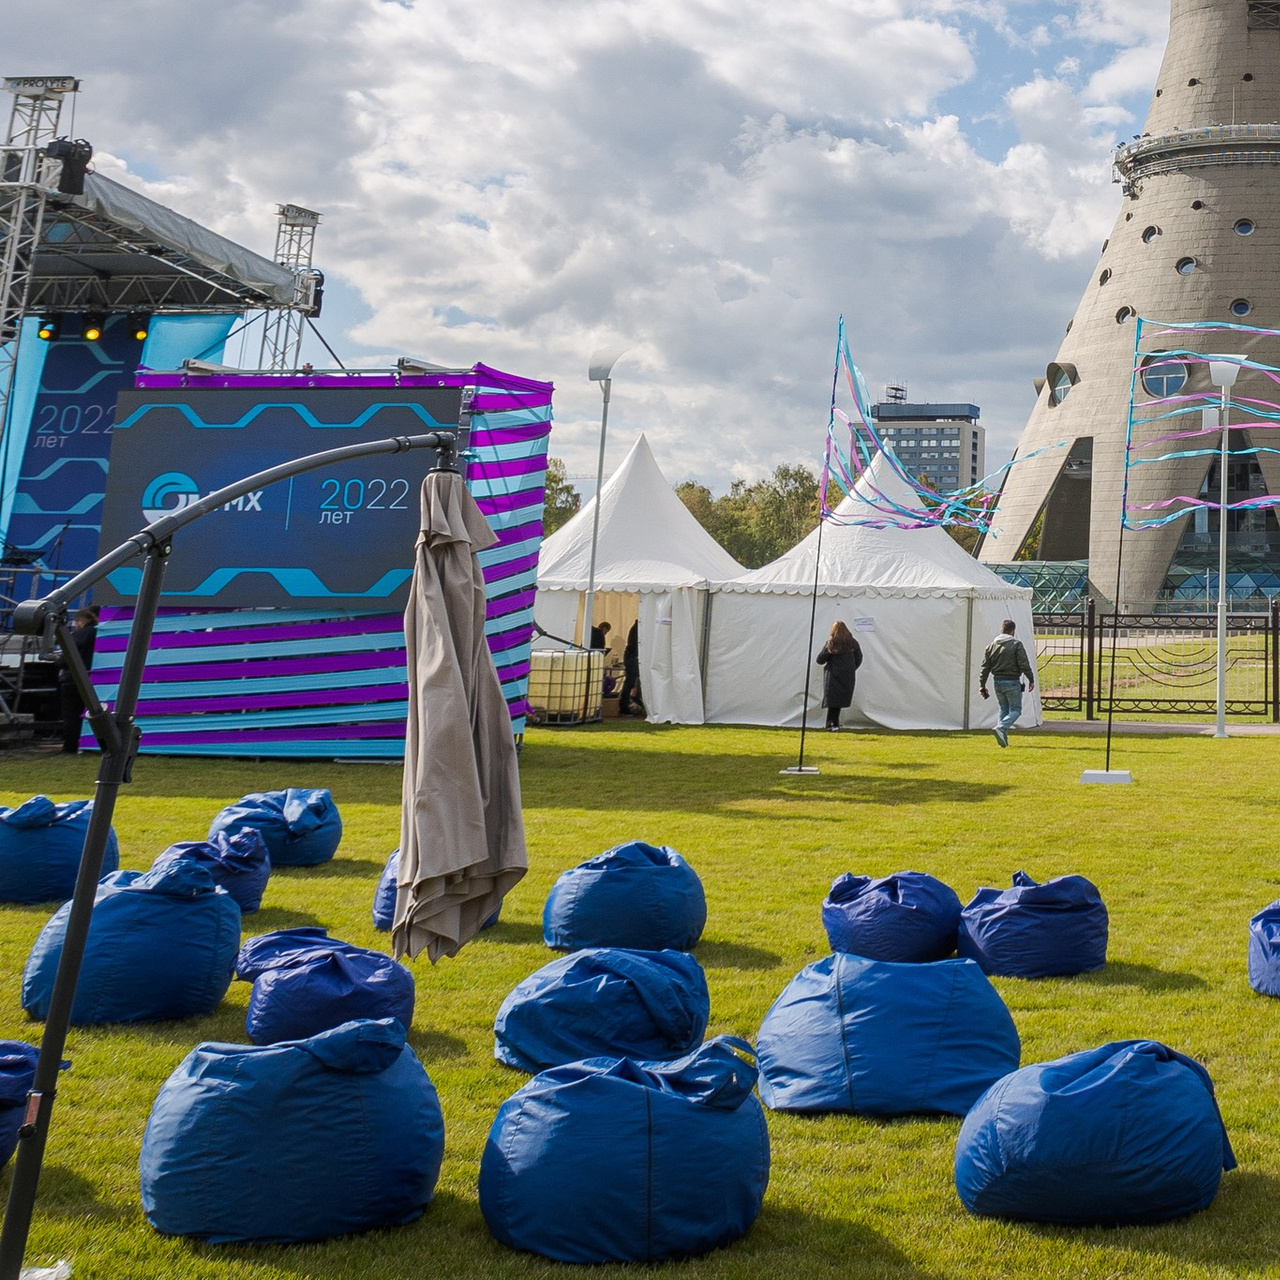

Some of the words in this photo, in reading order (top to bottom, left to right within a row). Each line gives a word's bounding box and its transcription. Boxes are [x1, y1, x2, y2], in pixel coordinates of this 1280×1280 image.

[33, 436, 69, 448] лет
[209, 491, 264, 512] МХ
[319, 478, 409, 510] 2022
[319, 511, 354, 525] лет
